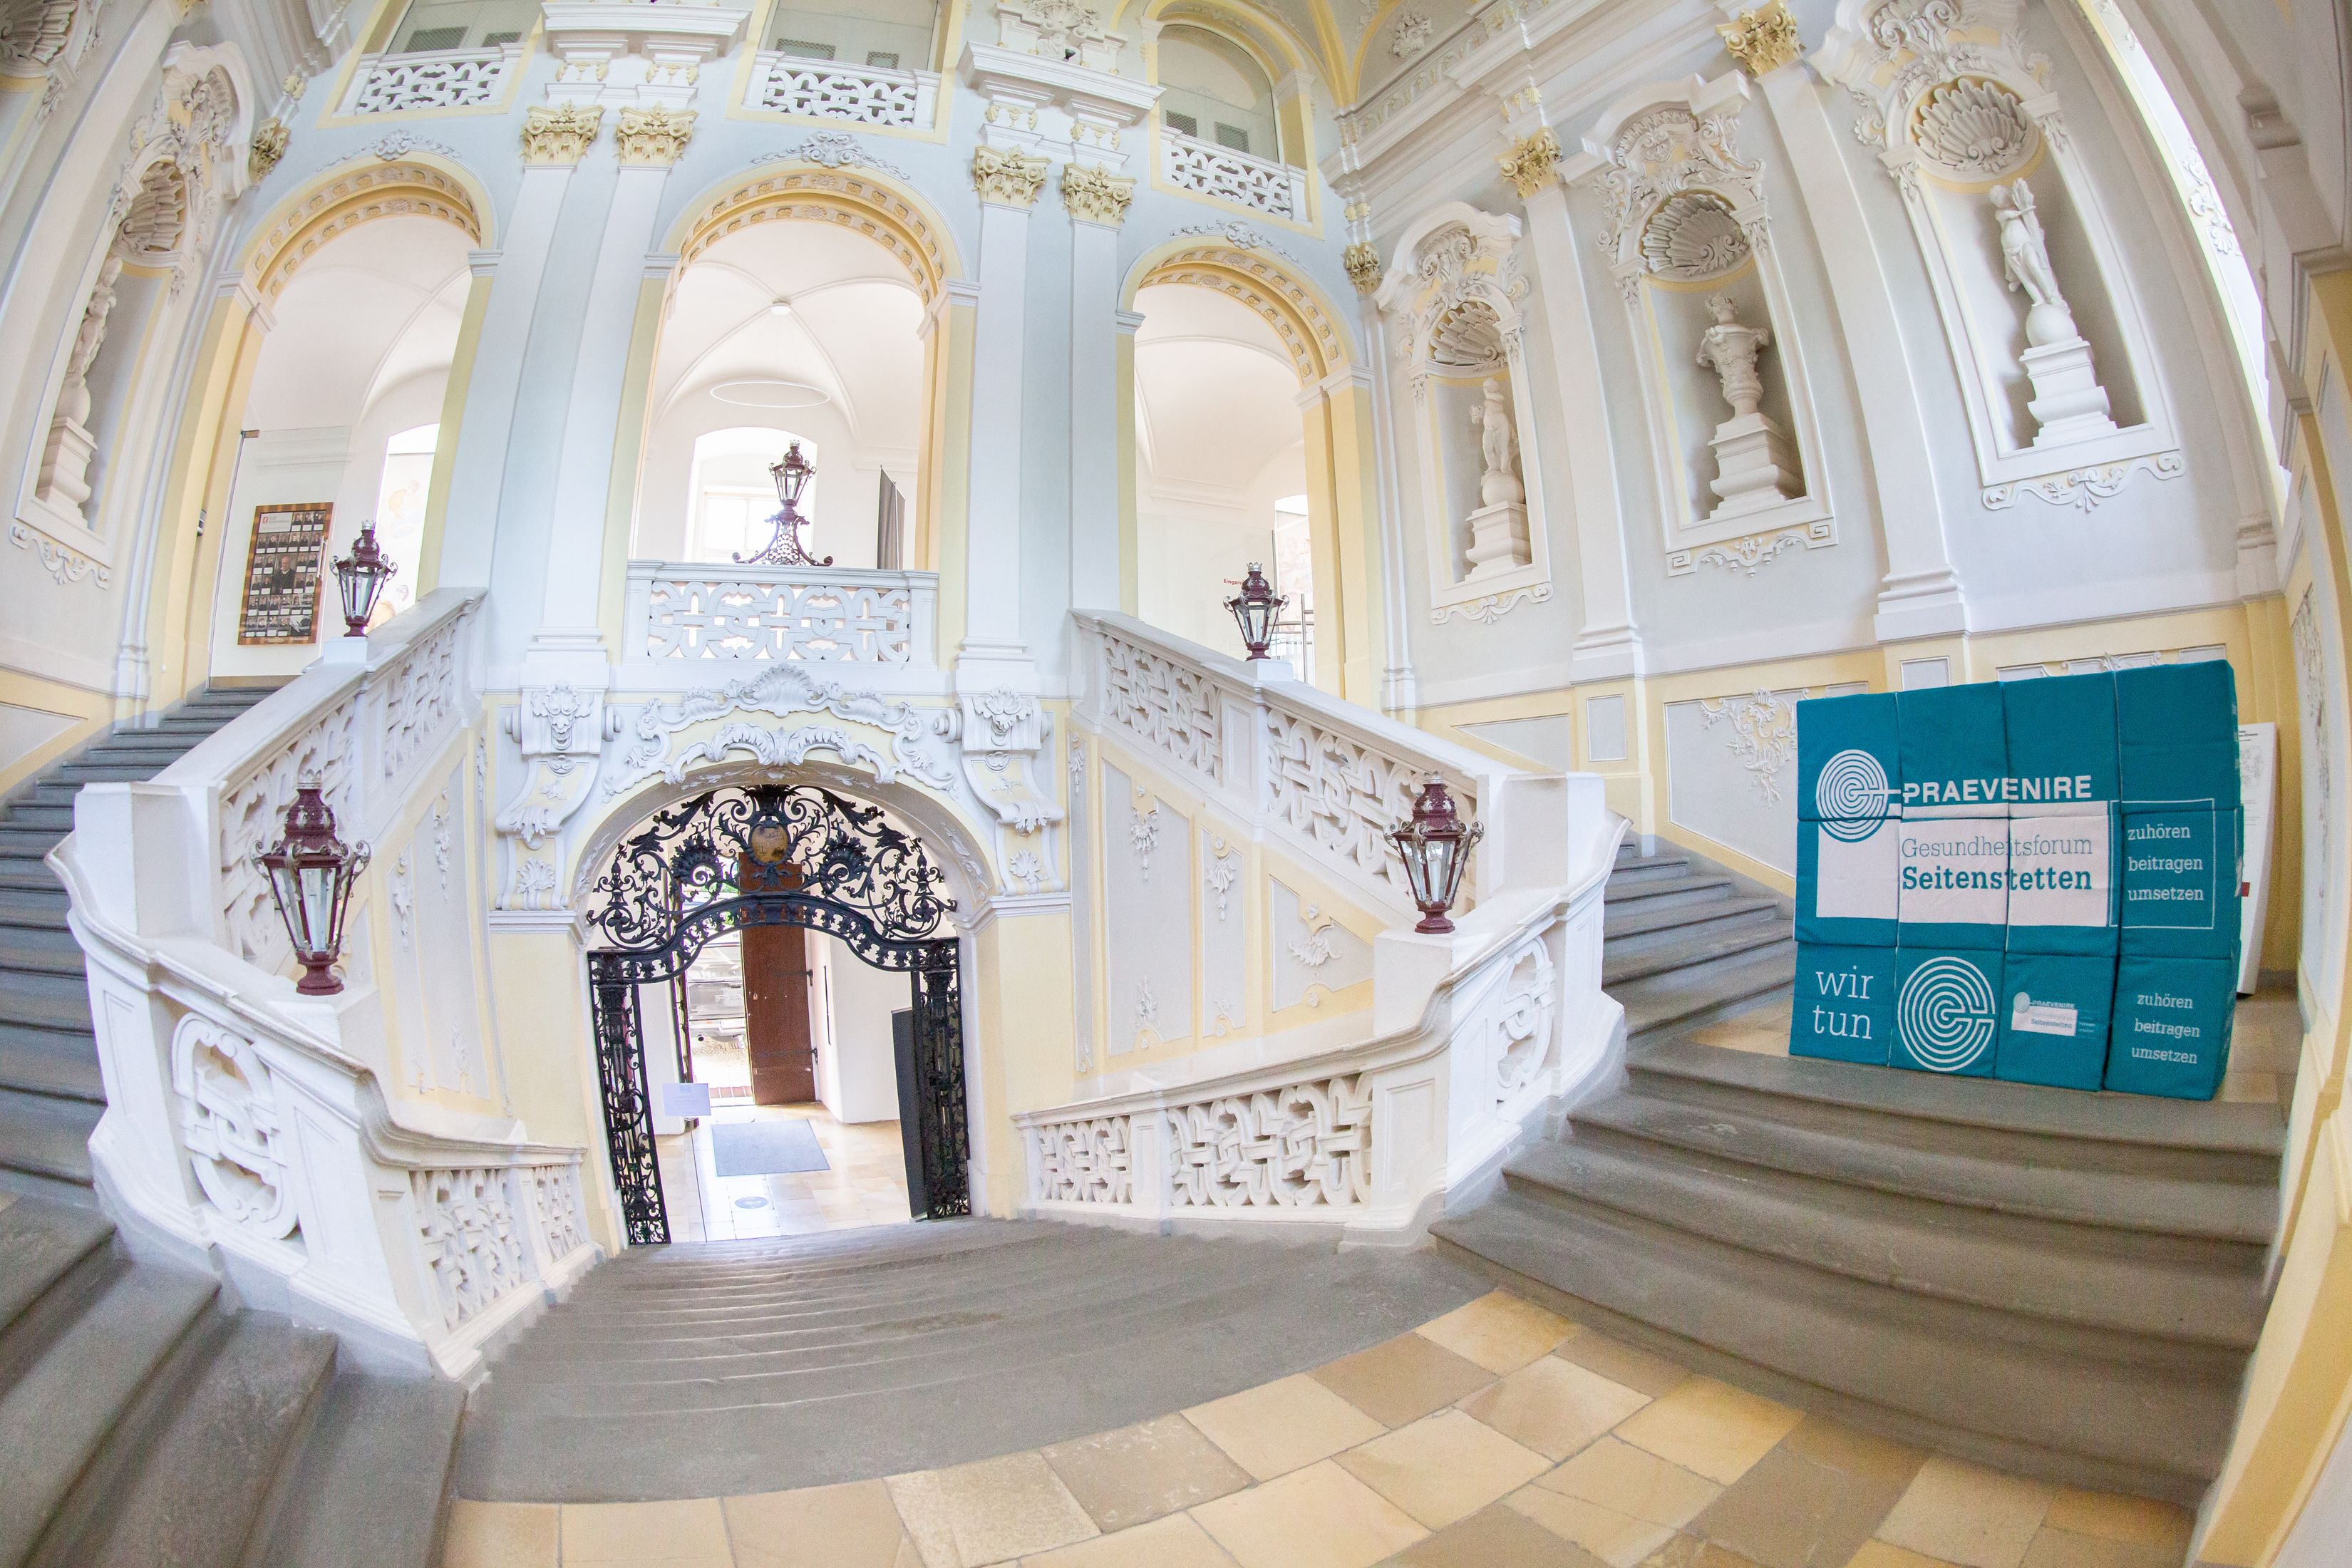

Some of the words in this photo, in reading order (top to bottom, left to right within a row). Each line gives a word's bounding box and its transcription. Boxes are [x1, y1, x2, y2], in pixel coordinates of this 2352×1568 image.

[1902, 775, 2092, 804] PRAEVENIRE
[2127, 823, 2191, 840] zuhören
[2128, 855, 2203, 874] beitragen
[1902, 865, 2092, 890] Seitenstetten
[2128, 887, 2204, 901] umsetzen
[1815, 965, 1874, 999] wir
[2033, 1000, 2075, 1009] PRAEVENIRE
[2137, 993, 2194, 1009] zuhören
[1812, 1005, 1872, 1040] tun
[2135, 1018, 2200, 1038] beitragen
[2132, 1047, 2197, 1064] umsetzen
